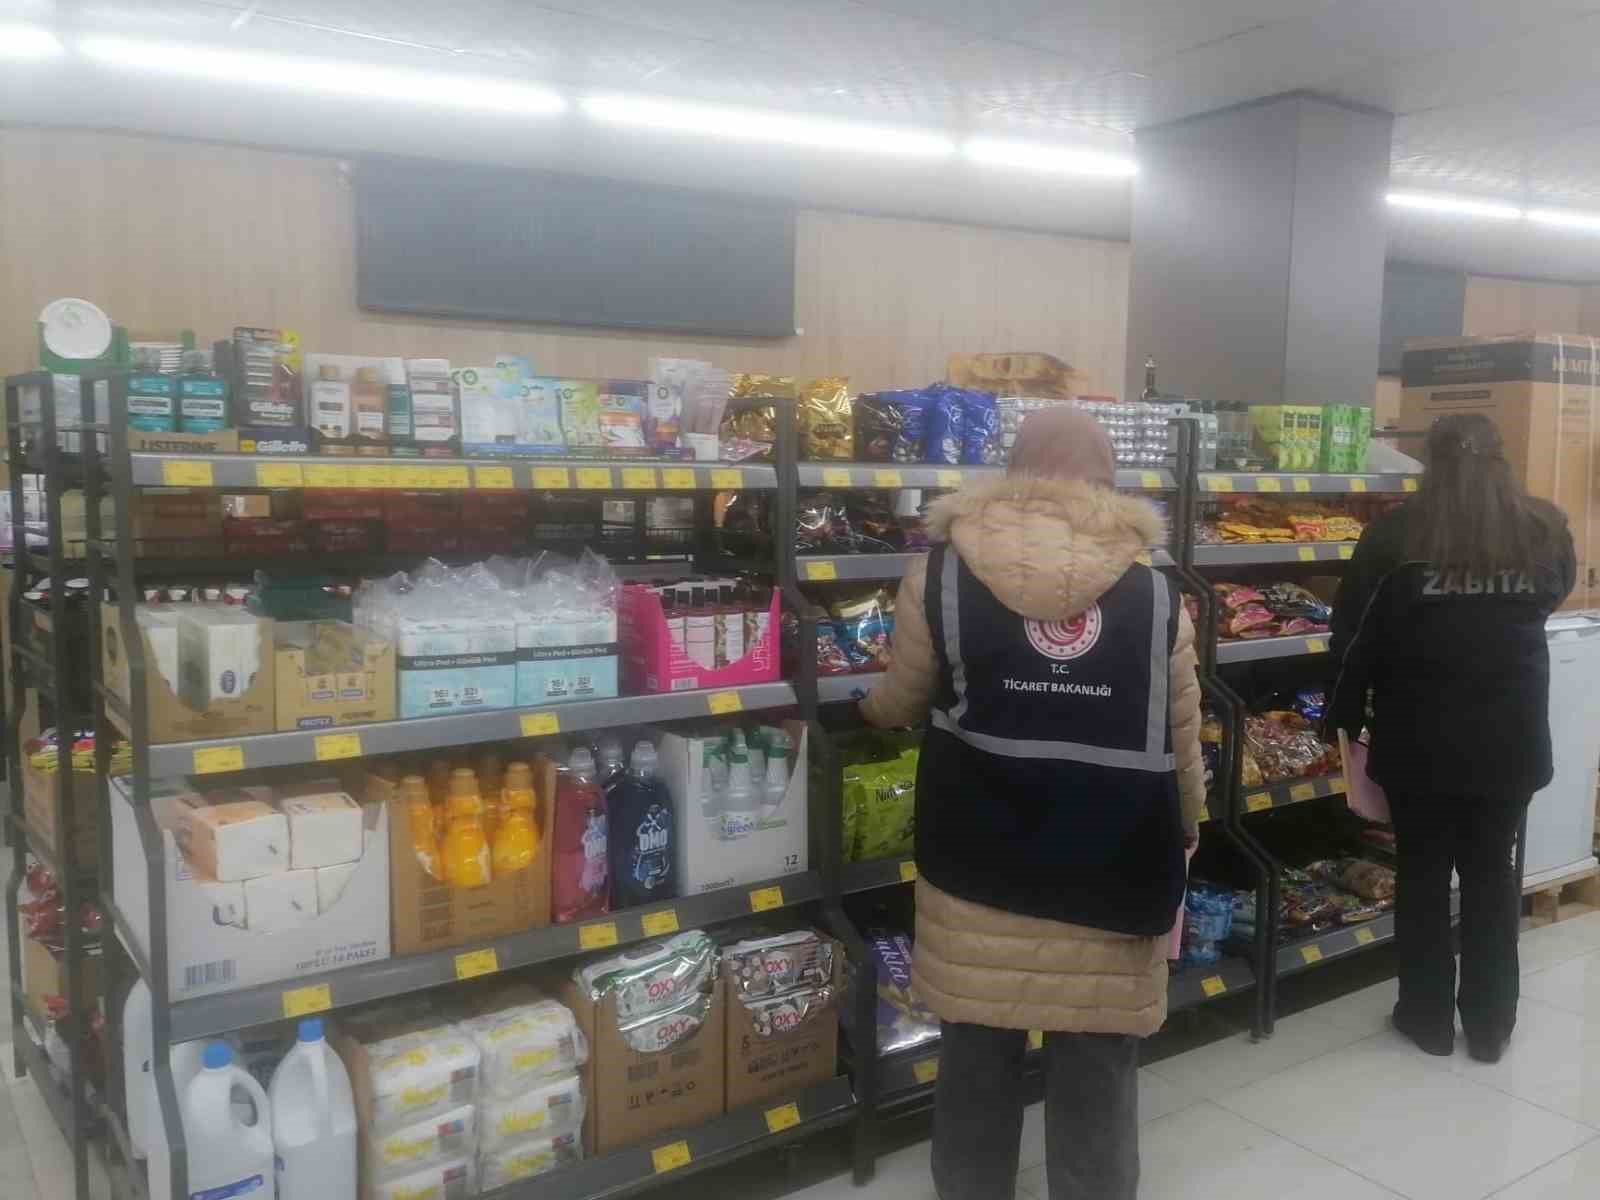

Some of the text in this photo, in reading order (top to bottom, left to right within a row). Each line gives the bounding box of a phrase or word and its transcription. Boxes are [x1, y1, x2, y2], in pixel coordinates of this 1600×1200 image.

[256, 440, 307, 453] Gillette
[1003, 678, 1112, 697] TİCARET BAKANLIĞI
[639, 829, 668, 851] OMO
[784, 854, 798, 866] 12
[765, 959, 793, 973] OXY
[656, 1017, 689, 1040] OXY
